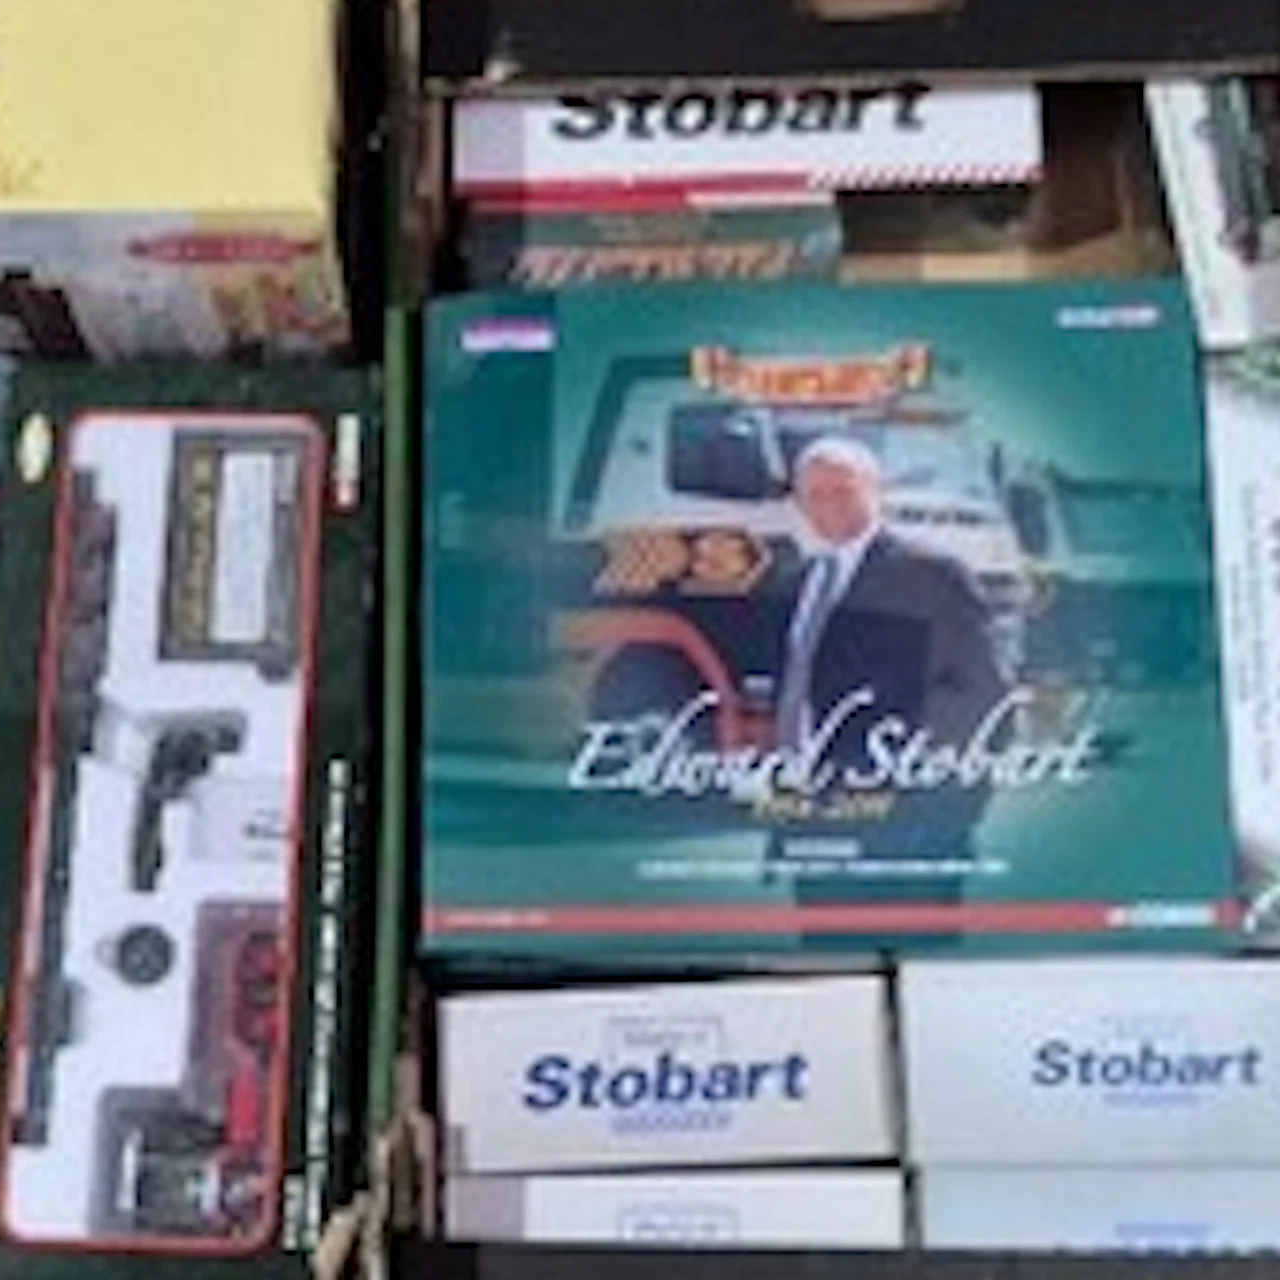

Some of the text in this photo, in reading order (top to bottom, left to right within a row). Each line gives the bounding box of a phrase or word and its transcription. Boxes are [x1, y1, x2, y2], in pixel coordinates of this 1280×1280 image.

[568, 687, 1097, 796] Edward Stobart
[521, 1050, 810, 1111] Stobart
[1031, 1040, 1263, 1087] Stobart
